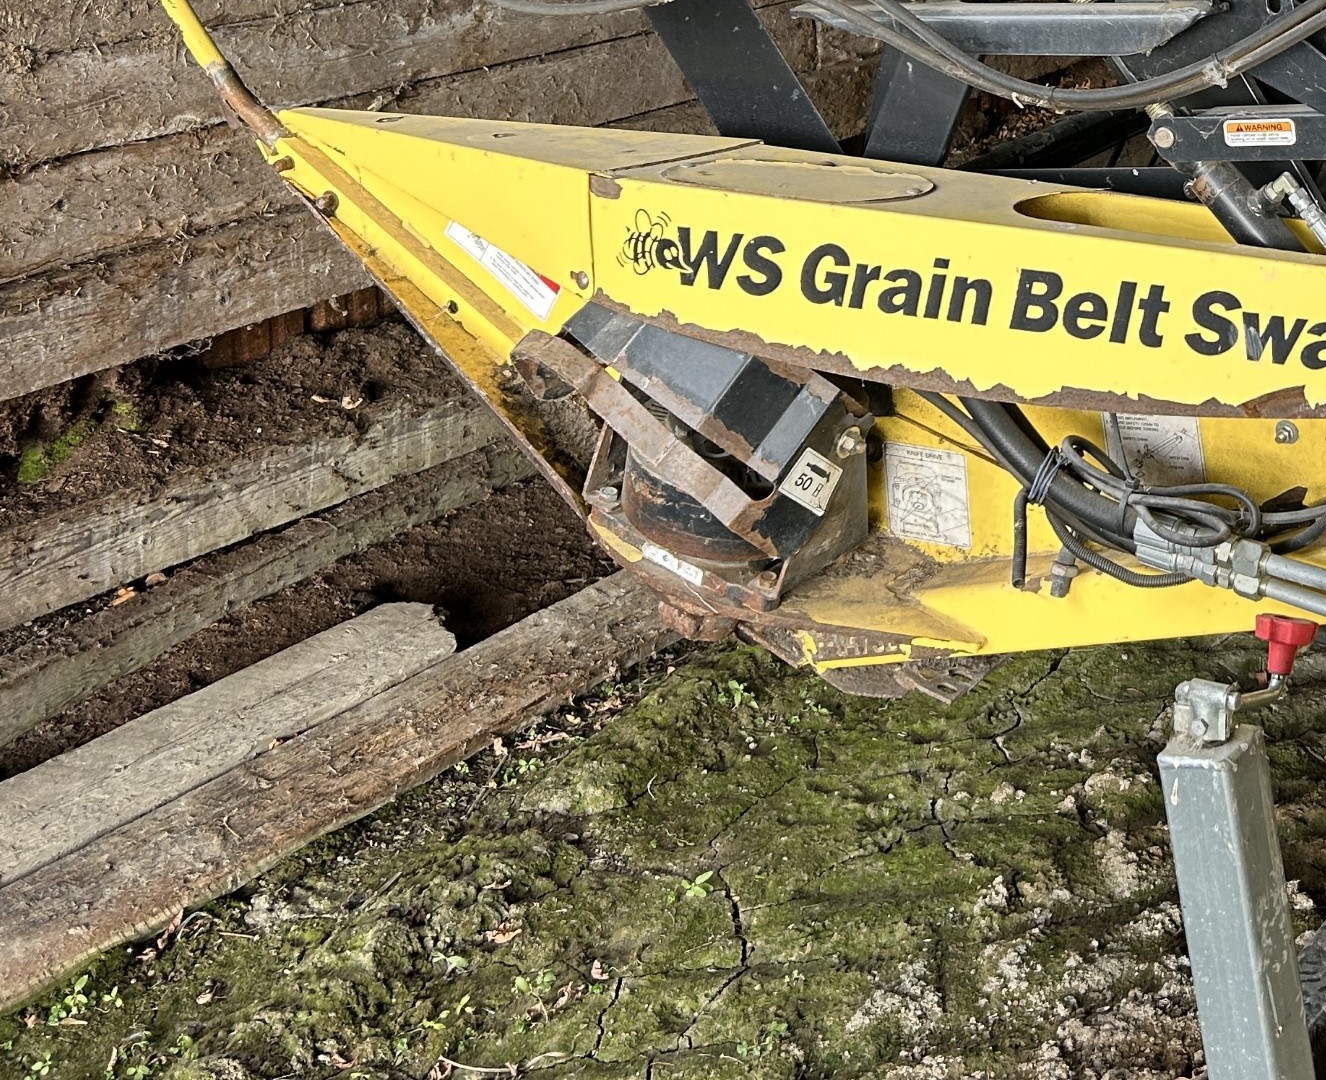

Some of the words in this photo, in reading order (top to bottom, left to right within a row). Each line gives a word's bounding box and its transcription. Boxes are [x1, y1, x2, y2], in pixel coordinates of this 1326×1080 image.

[1244, 123, 1283, 132] WARNING
[677, 226, 786, 297] WS
[800, 243, 993, 326] Grain
[1009, 268, 1171, 348] Belt
[795, 473, 813, 490] 50
